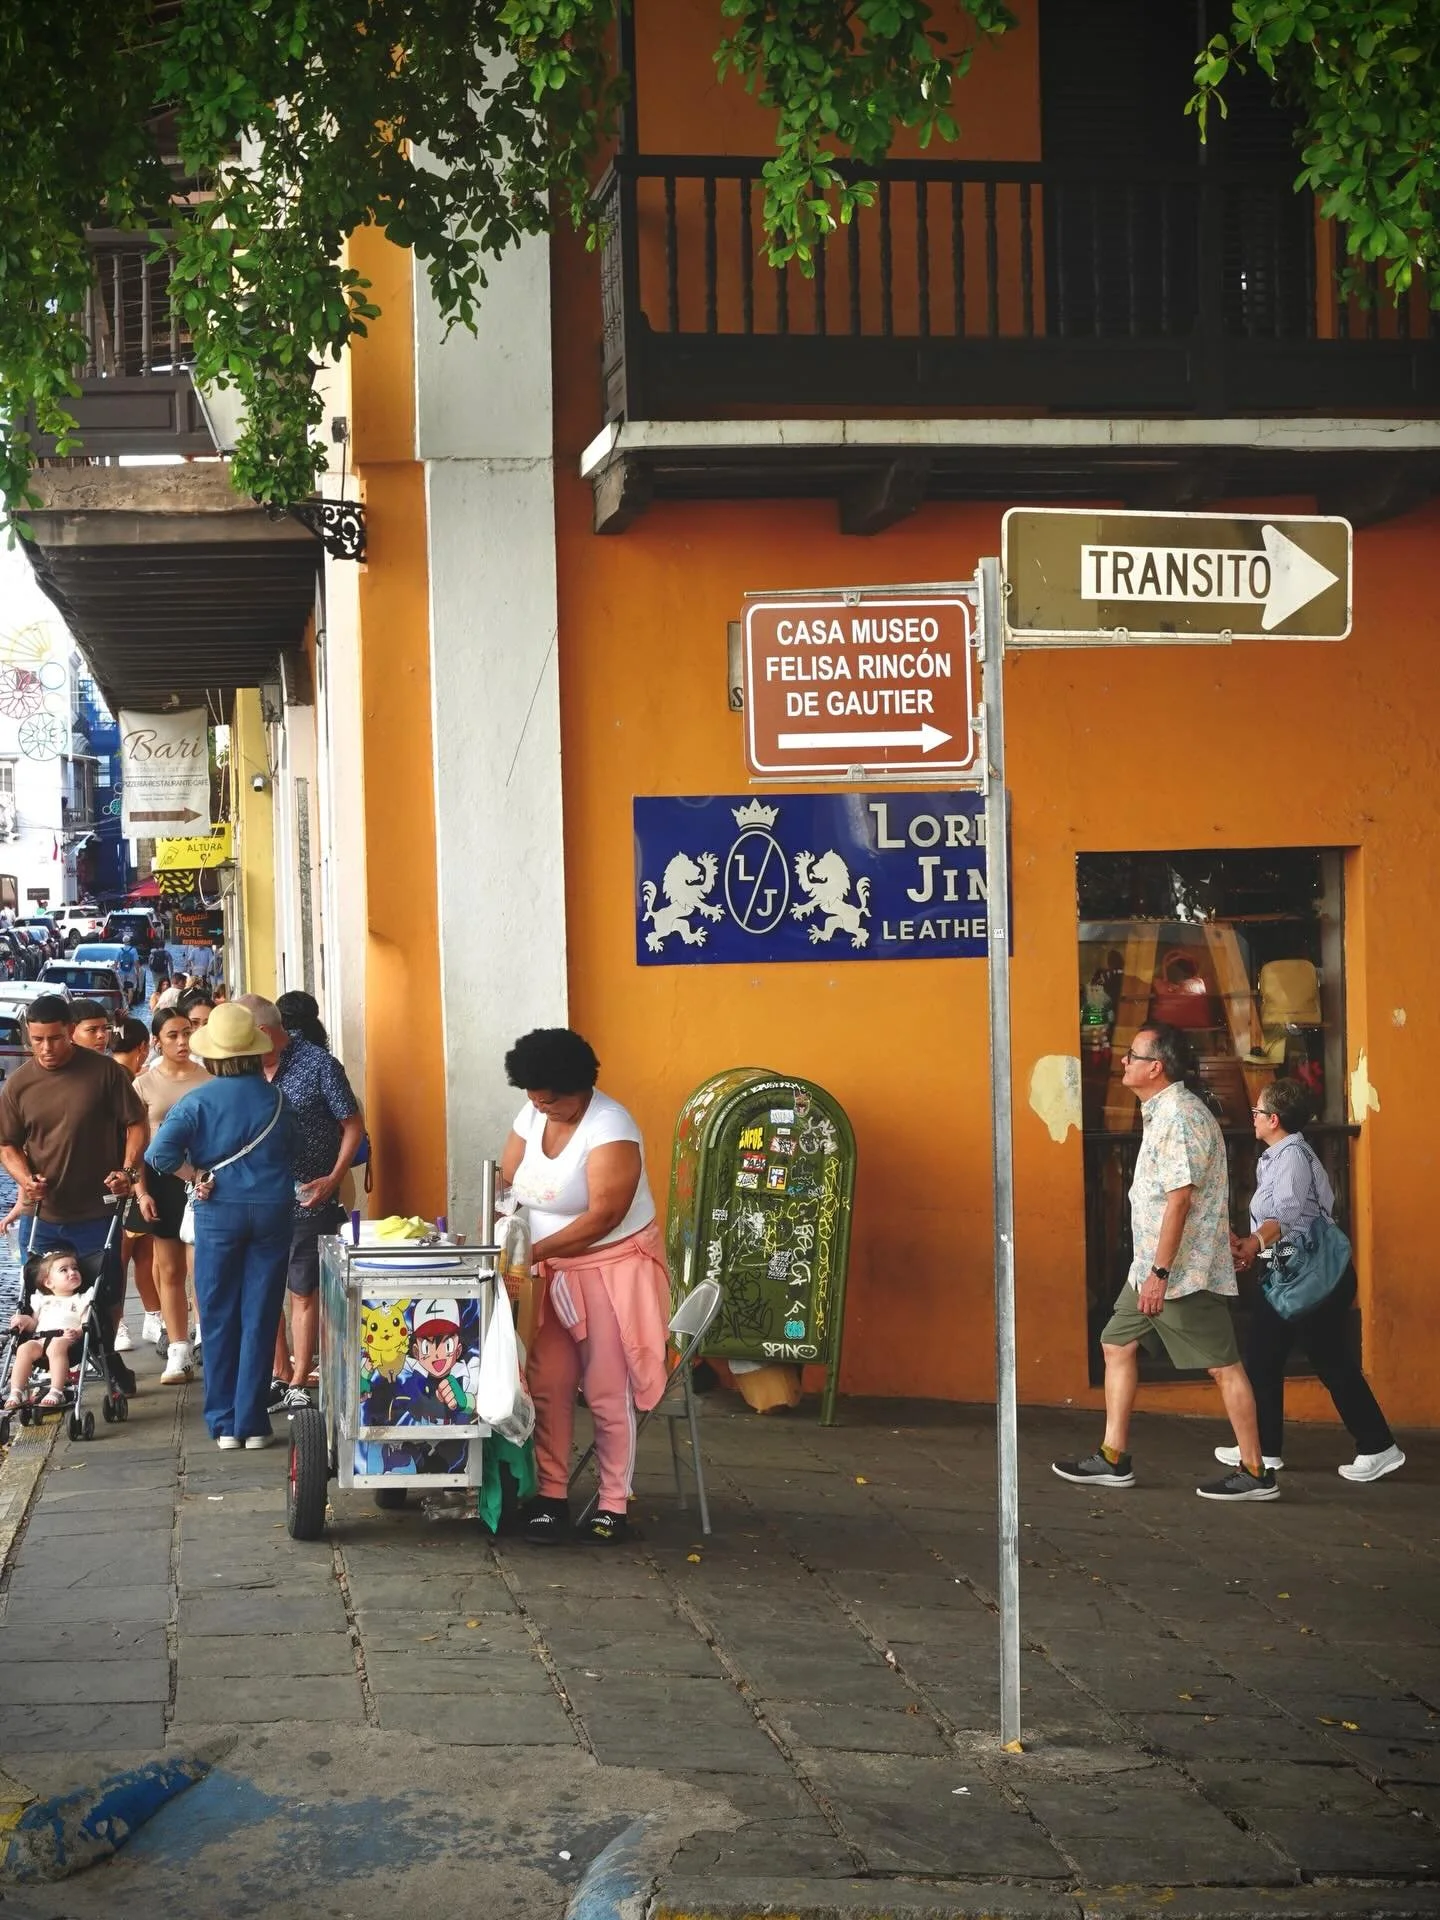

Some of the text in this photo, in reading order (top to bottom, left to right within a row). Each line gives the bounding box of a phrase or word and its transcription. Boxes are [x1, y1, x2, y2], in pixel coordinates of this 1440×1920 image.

[1089, 551, 1271, 599] TRANSITO
[776, 617, 939, 646] CASA MUSEO
[766, 648, 951, 682] FELISA RINCÓN
[786, 689, 935, 717] DE GAUTIER
[123, 729, 205, 762] Bari
[187, 842, 223, 852] ALTURA
[175, 926, 203, 937] TASTE
[882, 918, 987, 940] LEATHE
